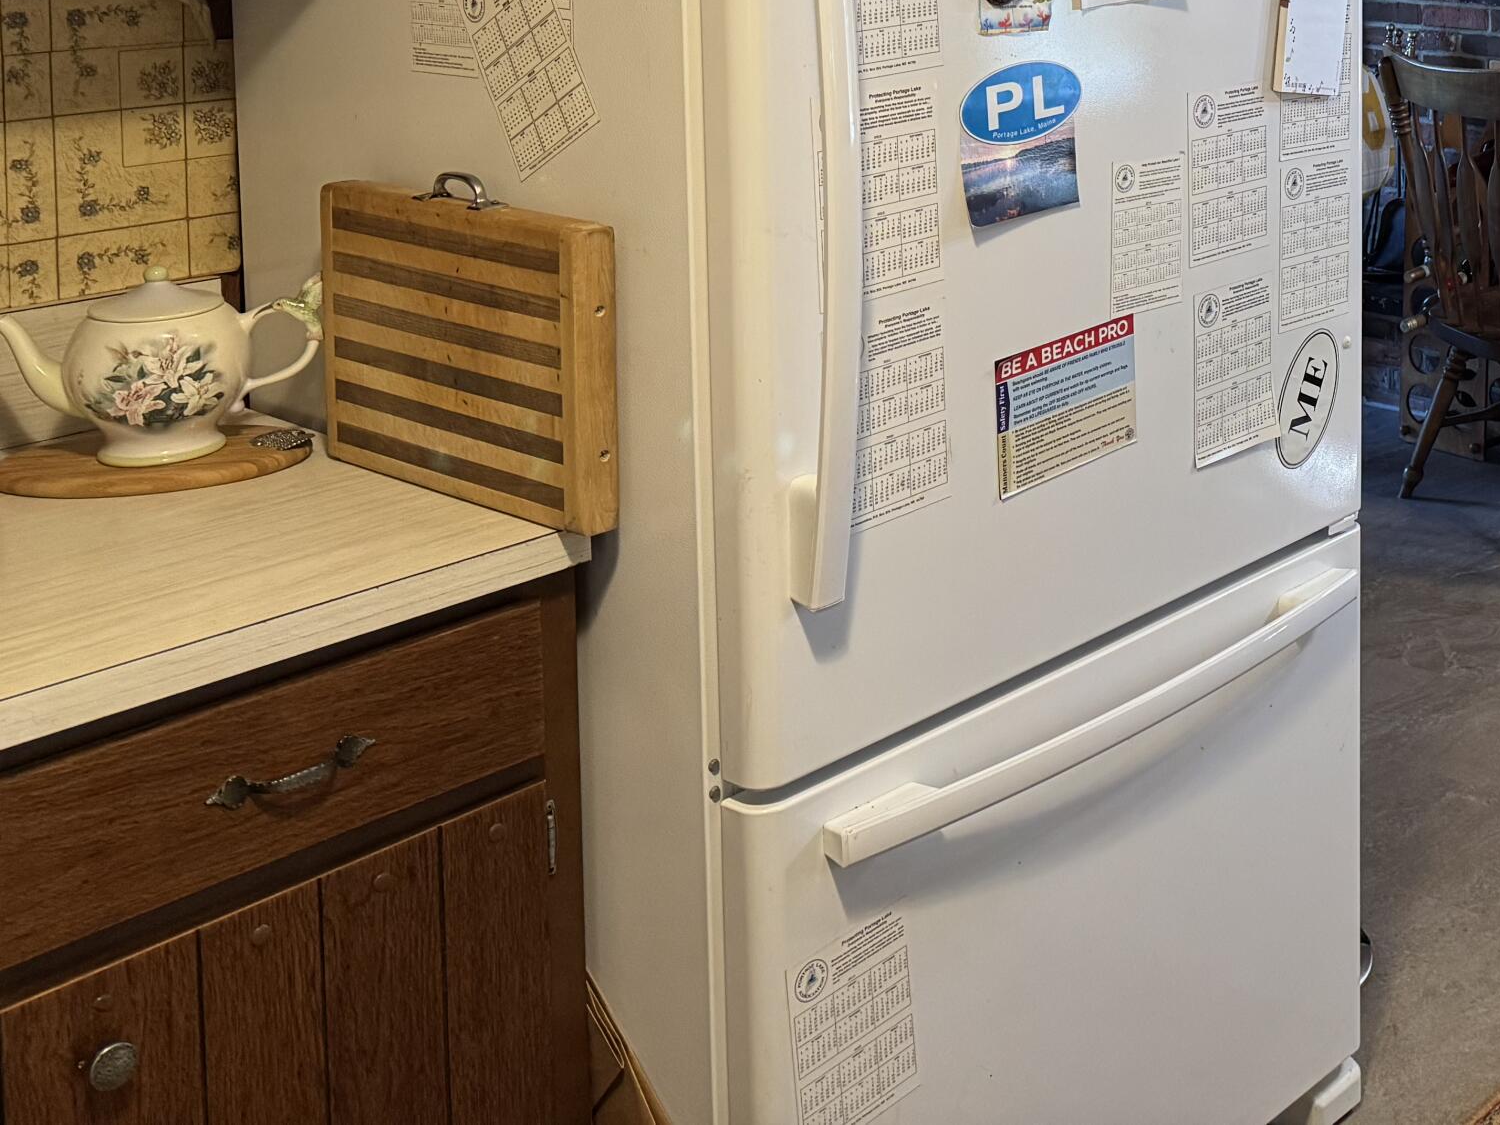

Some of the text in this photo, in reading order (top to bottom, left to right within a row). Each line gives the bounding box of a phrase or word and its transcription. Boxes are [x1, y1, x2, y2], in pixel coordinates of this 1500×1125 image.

[986, 75, 1064, 131] PL
[992, 131, 1017, 139] Portage
[1038, 118, 1056, 129] Maine
[879, 314, 901, 325] Protecting
[902, 310, 919, 319] Portage
[1001, 320, 1128, 378] BE A BEACH PRO
[1049, 365, 1061, 373] AWARE
[1067, 357, 1081, 366] FRIENDS
[1089, 350, 1100, 358] FAMILY
[1042, 381, 1060, 391] EVERYONE
[1014, 402, 1026, 411] LEARN
[1026, 398, 1038, 407] ABOUT
[1045, 388, 1063, 399] CURRENTS
[1055, 394, 1069, 404] SEASON
[1288, 357, 1328, 441] ME
[1035, 408, 1056, 419] LIFEGUARDS
